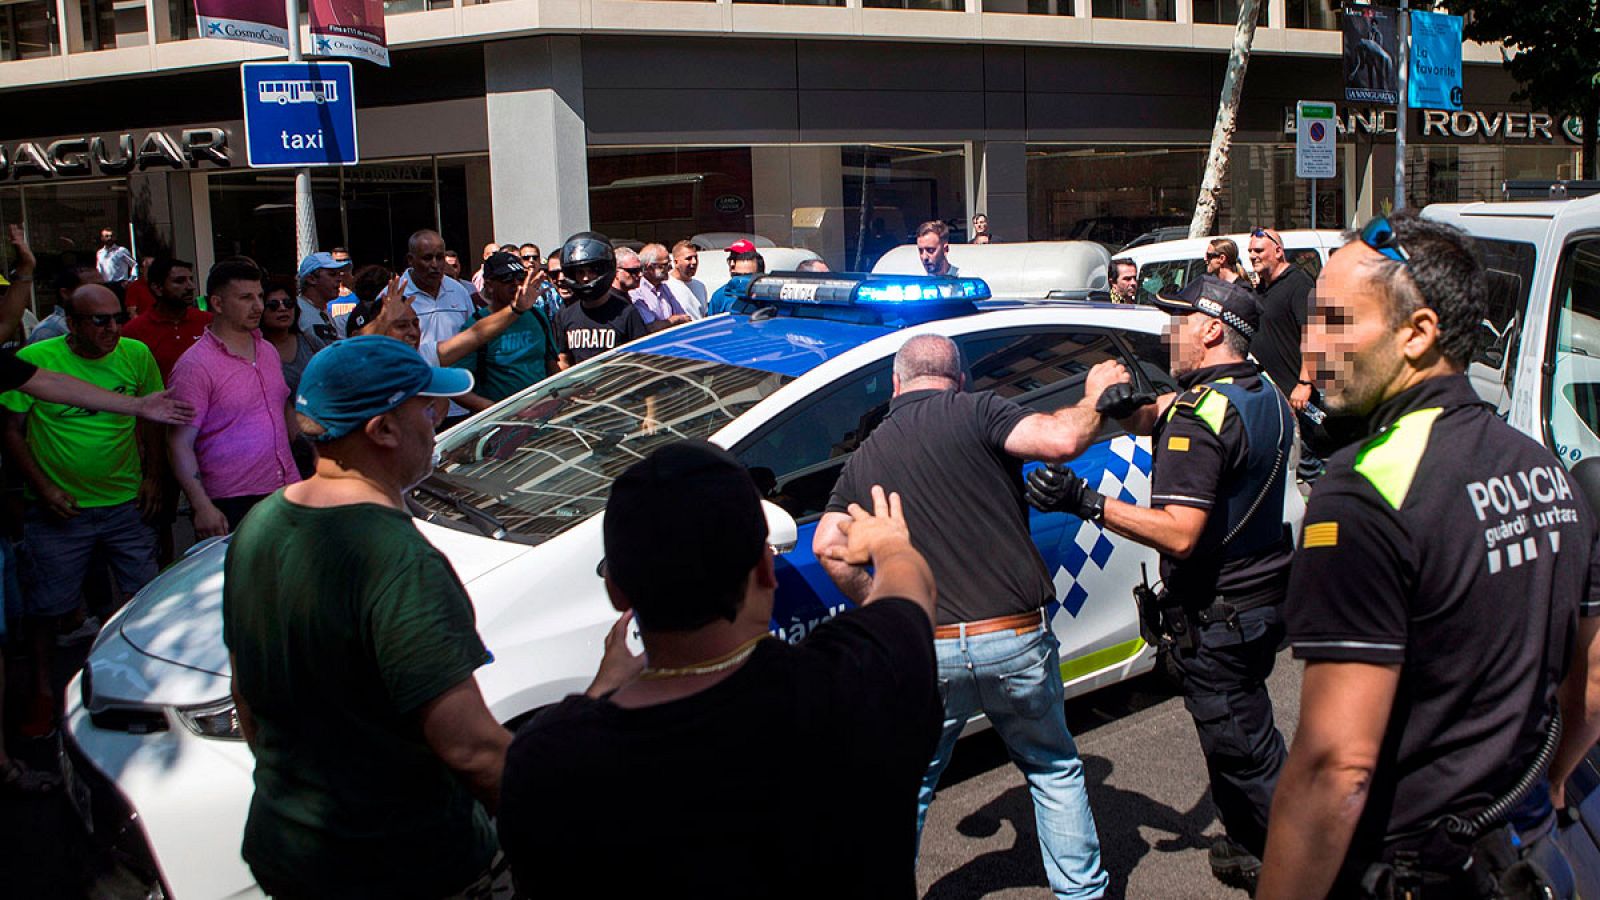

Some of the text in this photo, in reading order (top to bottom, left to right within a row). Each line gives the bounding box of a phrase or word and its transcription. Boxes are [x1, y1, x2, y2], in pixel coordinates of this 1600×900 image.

[225, 25, 285, 44] CosmoCaixa
[1416, 45, 1428, 57] La
[1423, 109, 1553, 138] ROVER
[281, 130, 324, 149] taxi
[500, 329, 534, 352] NIKE
